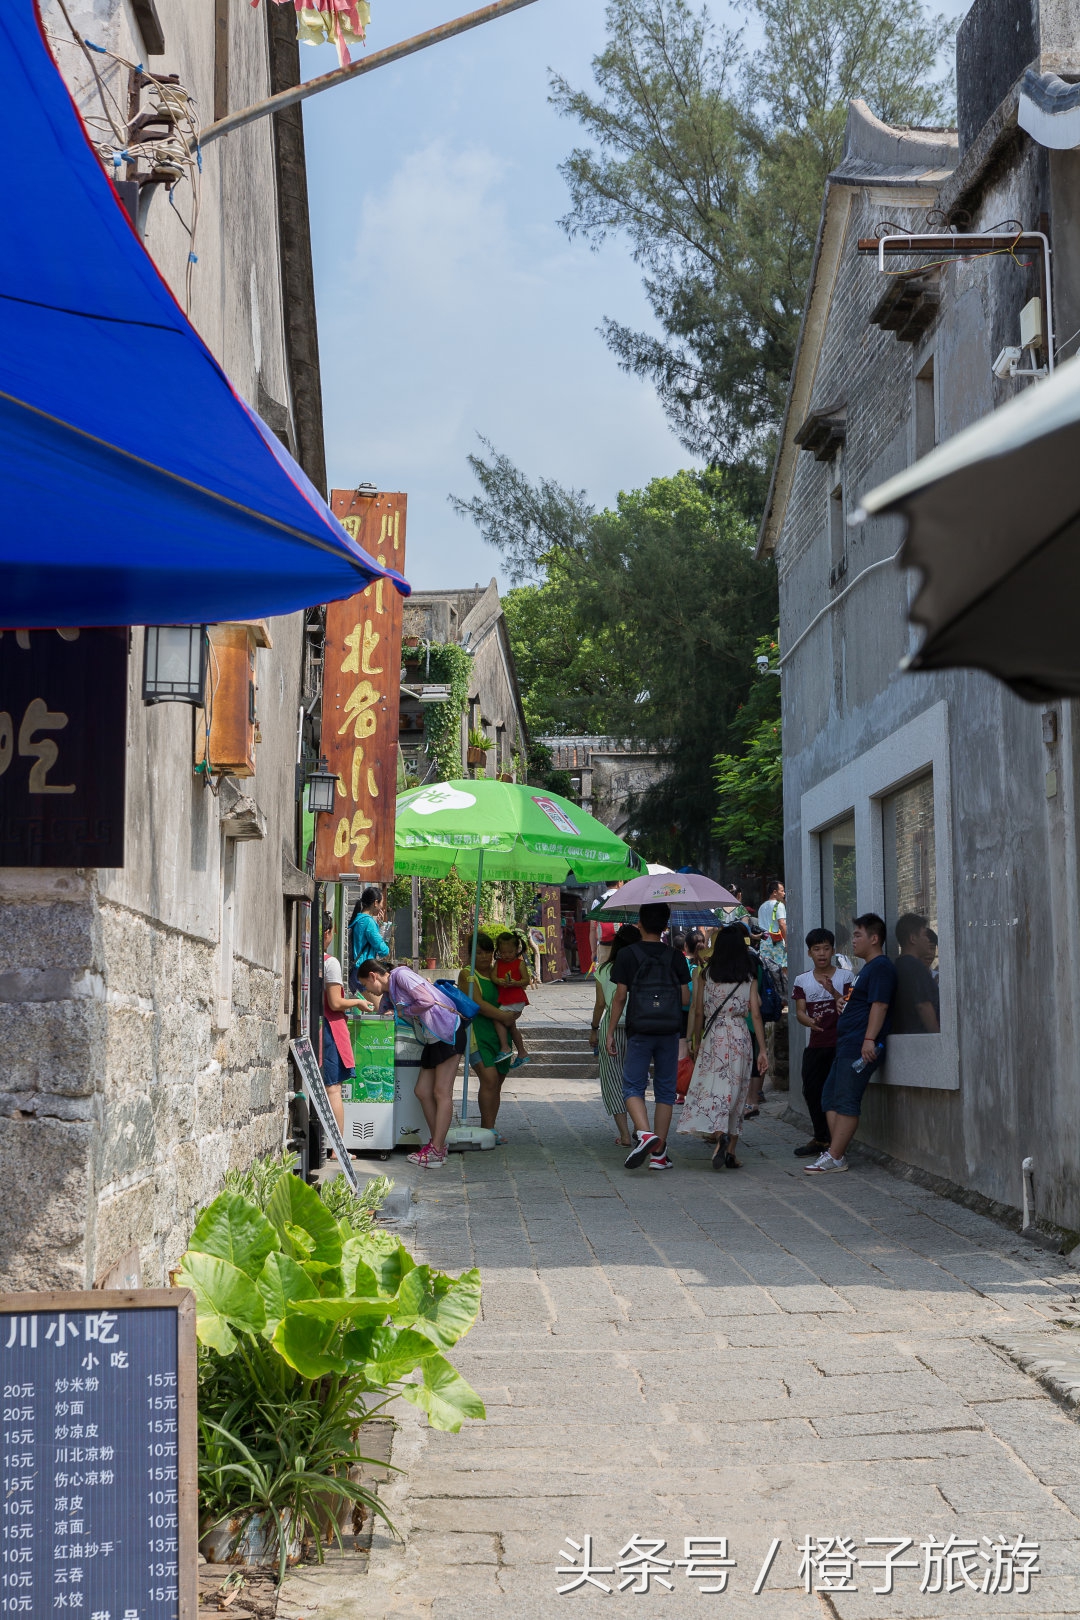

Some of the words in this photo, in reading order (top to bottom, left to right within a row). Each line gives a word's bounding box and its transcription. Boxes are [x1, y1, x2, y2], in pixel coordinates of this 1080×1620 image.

[5, 1311, 120, 1348] 川小吃
[81, 1351, 129, 1370] 小吃
[4, 1383, 35, 1398] 20元
[54, 1377, 99, 1393] 炒米粉
[147, 1372, 177, 1387] 15元
[4, 1406, 35, 1421] 20元
[54, 1400, 84, 1416] 炒面
[147, 1395, 177, 1410] 15元
[4, 1429, 35, 1444] 15元
[54, 1423, 99, 1439] 炒凉皮
[147, 1418, 177, 1433] 15元
[3, 1453, 34, 1468] 15元
[54, 1446, 114, 1463] 川北凉粉
[147, 1442, 177, 1457] 10元
[3, 1476, 34, 1491] 15元
[54, 1470, 114, 1488] 伤心凉粉
[147, 1466, 177, 1481] 15元
[3, 1500, 34, 1515] 10元
[54, 1495, 84, 1511] 凉皮
[147, 1490, 177, 1505] 10元
[2, 1524, 33, 1539] 15元
[54, 1519, 84, 1535] 凉面
[147, 1514, 177, 1529] 10元
[2, 1548, 33, 1563] 10元
[53, 1542, 114, 1560] 红油抄手
[147, 1538, 177, 1553] 13元
[2, 1572, 33, 1587] 10元
[53, 1567, 84, 1583] 云吞
[147, 1562, 177, 1577] 13元
[2, 1596, 33, 1611] 10元
[53, 1591, 84, 1608] 水饺
[147, 1586, 177, 1601] 15元
